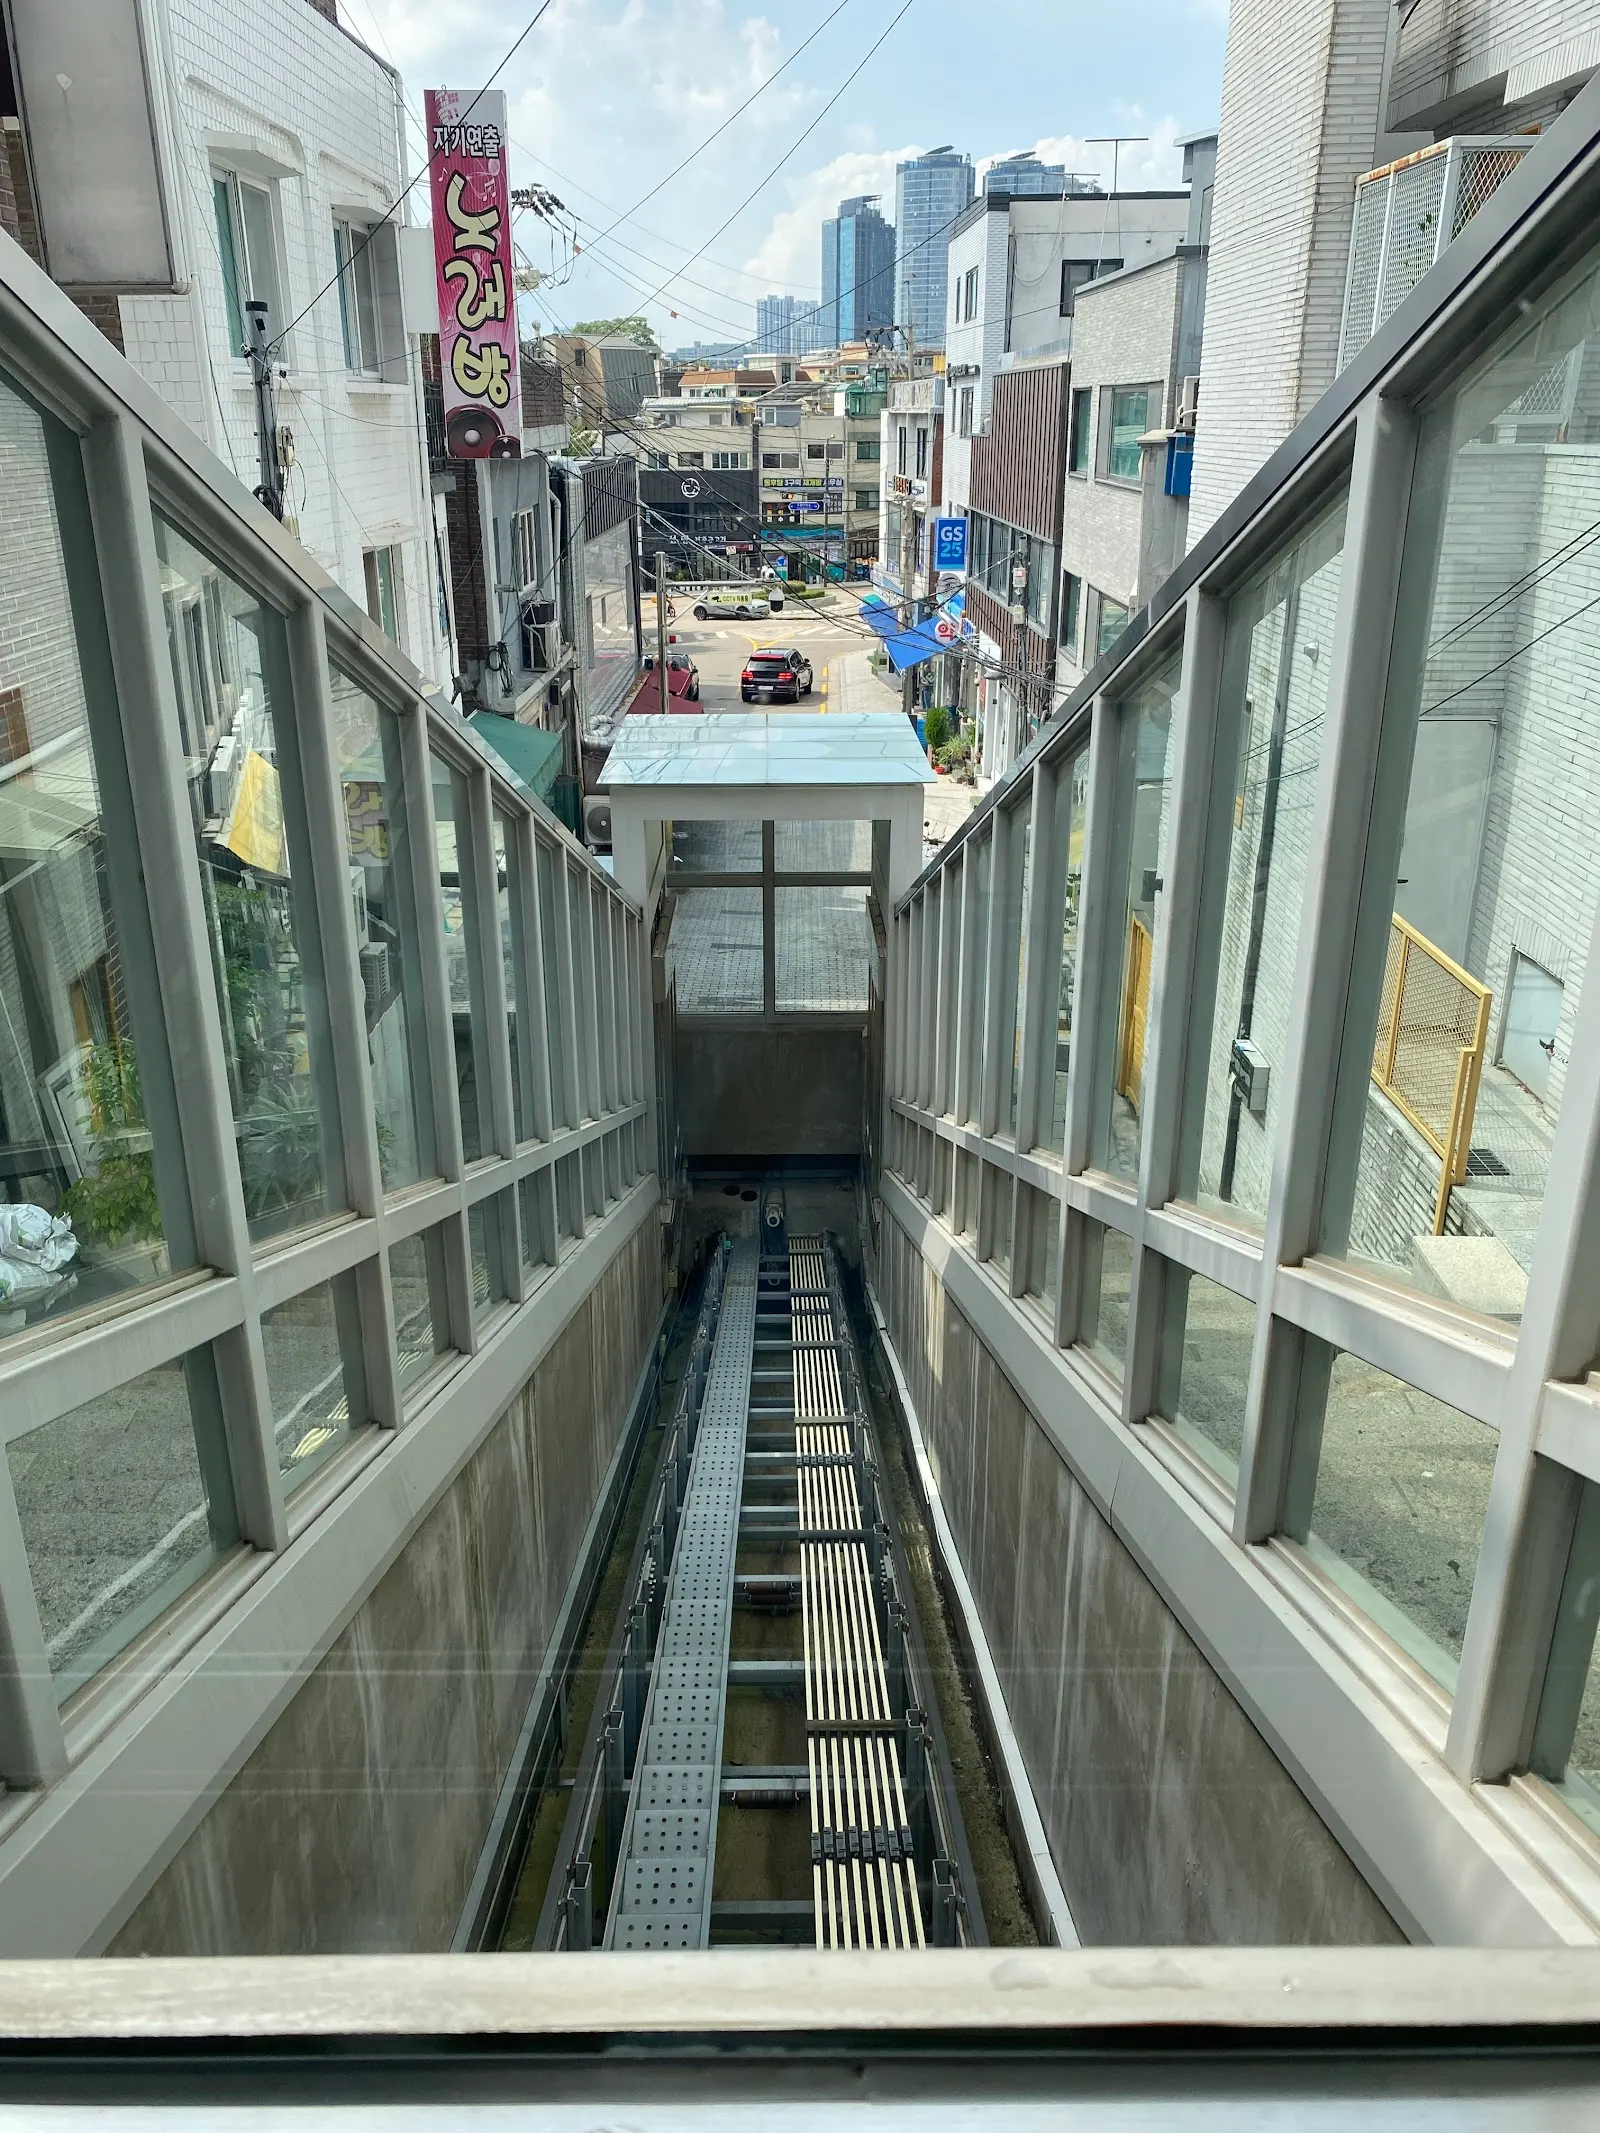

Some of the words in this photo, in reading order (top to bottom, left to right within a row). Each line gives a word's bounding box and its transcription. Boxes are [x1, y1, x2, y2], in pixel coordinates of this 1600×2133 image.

[433, 124, 500, 158] 자기연출
[443, 170, 511, 408] 노래방
[784, 478, 802, 487] 3구역
[802, 478, 822, 487] 재개발
[940, 526, 964, 542] GS
[940, 542, 963, 558] 25
